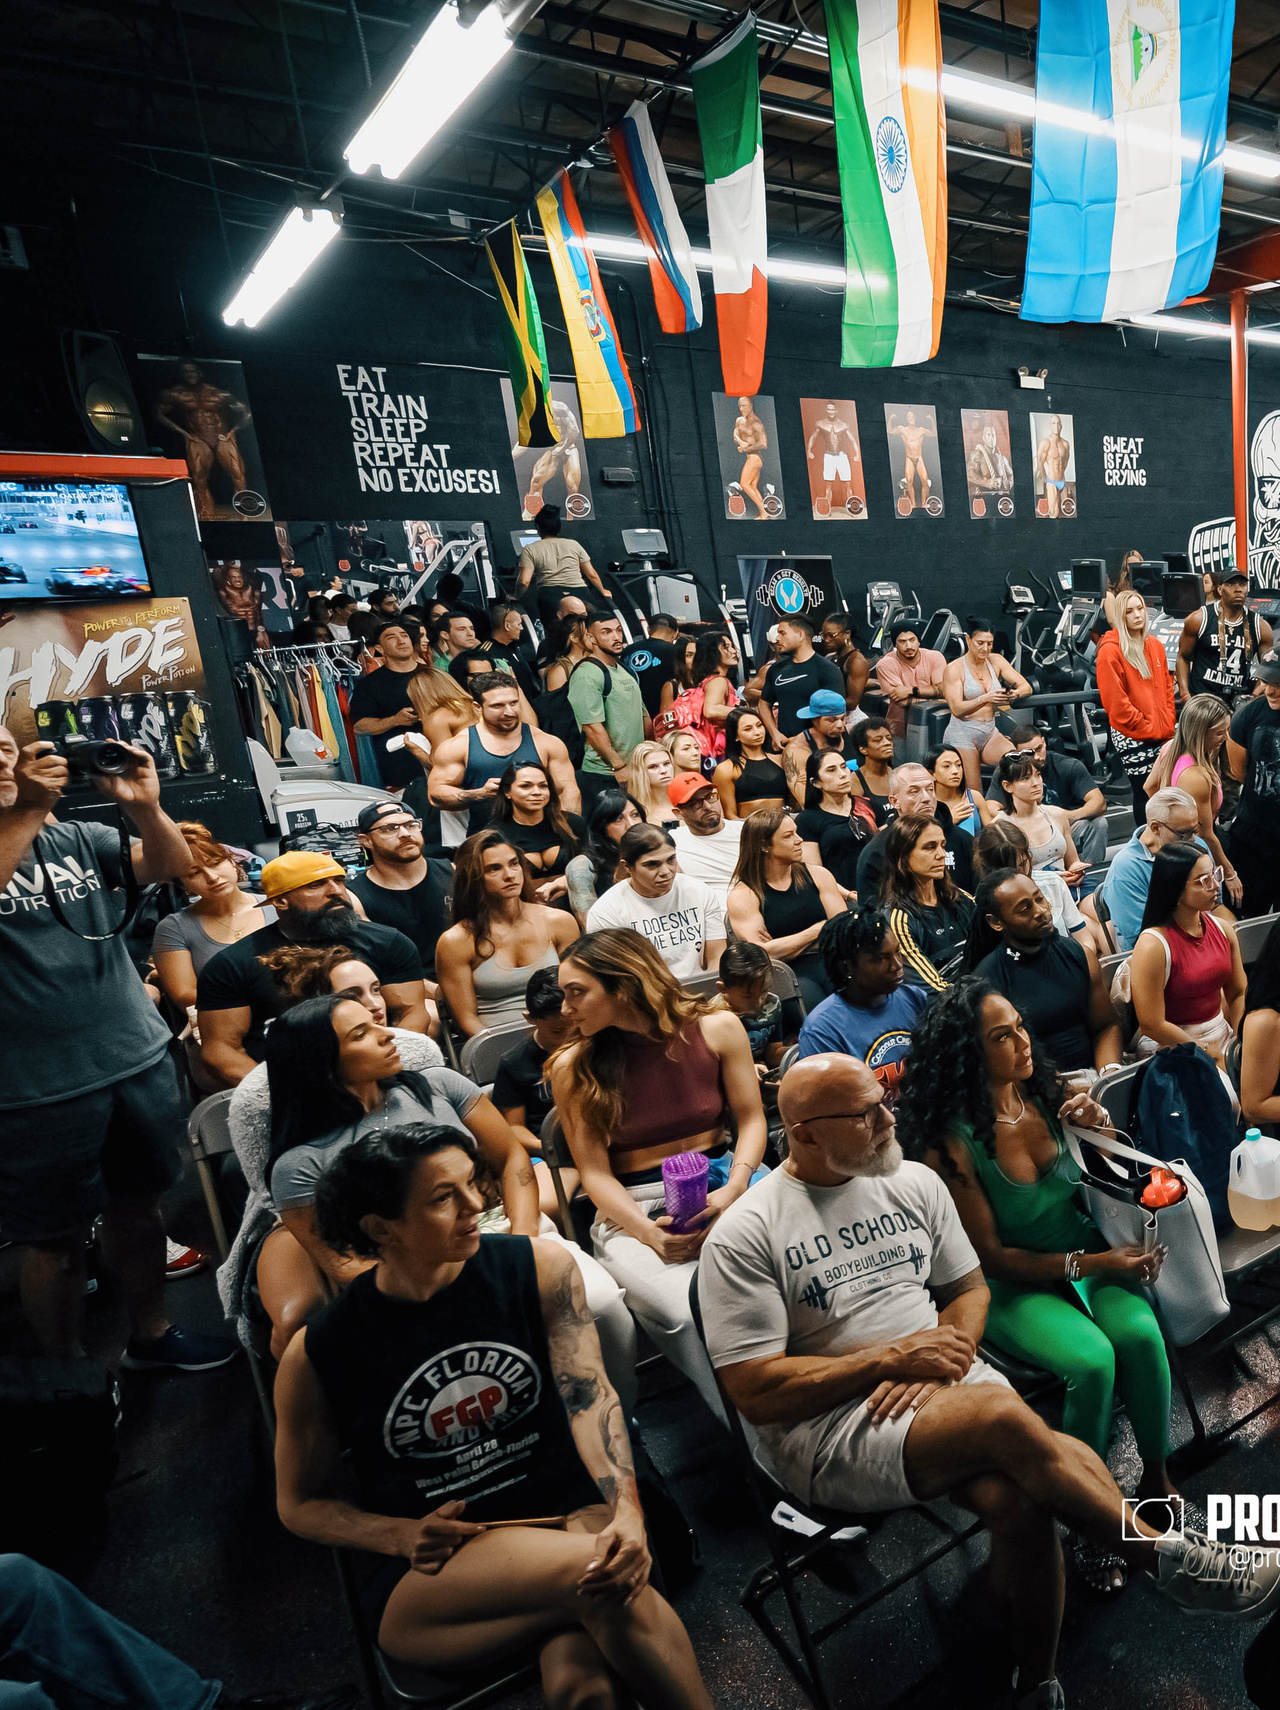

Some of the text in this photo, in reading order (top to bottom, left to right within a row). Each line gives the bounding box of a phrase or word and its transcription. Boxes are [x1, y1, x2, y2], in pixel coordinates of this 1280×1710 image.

[336, 364, 387, 393] EAT
[341, 391, 429, 420] TRAIN
[350, 417, 427, 443] SLEEP
[352, 441, 451, 468] REPEAT
[1102, 435, 1145, 455] SWEAT
[1103, 452, 1139, 470] IS FAT
[357, 467, 501, 494] NO EXCUSES!
[1104, 468, 1147, 487] CRYING
[83, 618, 120, 639] POWER
[134, 604, 182, 625] PERFORM
[0, 617, 188, 727] HYDE
[141, 664, 196, 691] POWER POTION
[0, 855, 95, 900] IVAL
[0, 875, 101, 915] UTRTION
[642, 907, 699, 936] DOESN'T
[669, 923, 702, 946] EASY
[785, 1209, 920, 1271] OLD SCHOOL
[824, 1245, 906, 1284] BODYBUILDING
[849, 1276, 882, 1293] CLOTHING
[393, 1395, 430, 1446] NPC
[423, 1350, 534, 1396] FLORIDA
[430, 1385, 503, 1439] FGP
[456, 1444, 483, 1465] April
[443, 1464, 471, 1481] Palm
